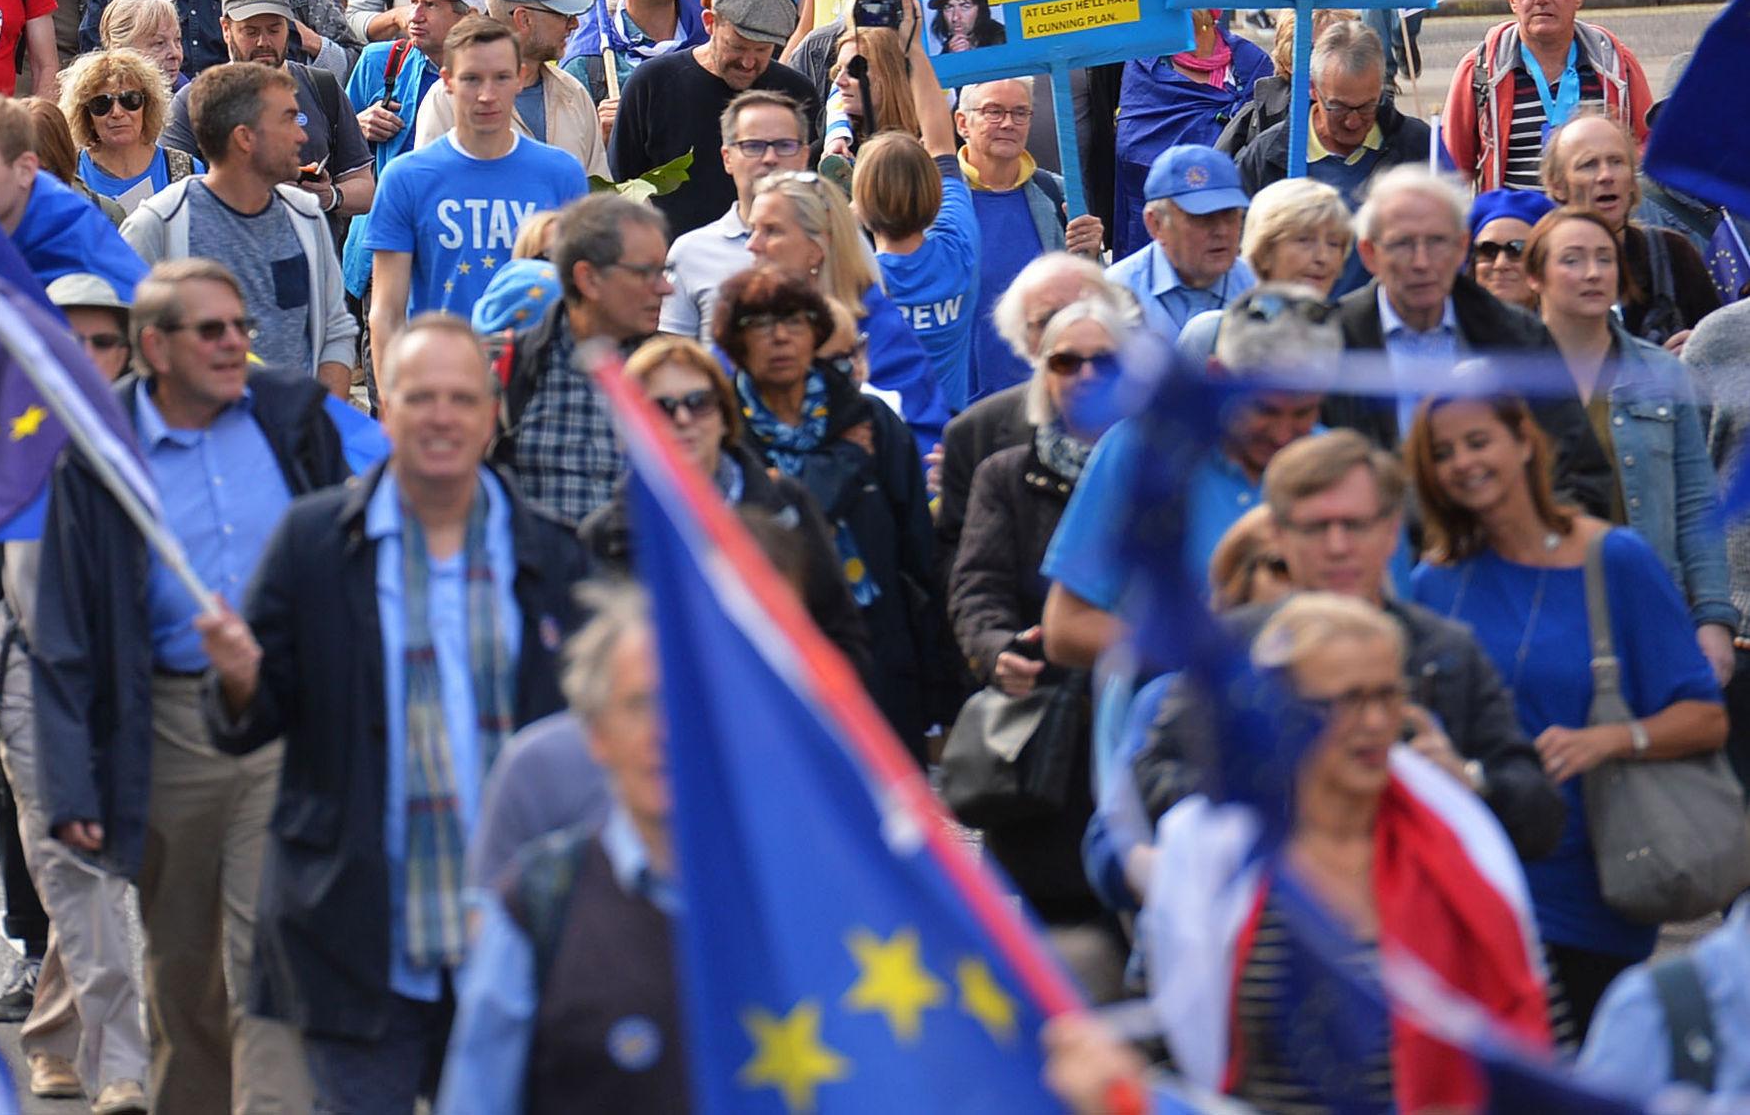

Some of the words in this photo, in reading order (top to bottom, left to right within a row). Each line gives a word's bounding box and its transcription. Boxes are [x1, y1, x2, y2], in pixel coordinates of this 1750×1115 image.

[1025, 6, 1039, 17] AT
[1040, 1, 1073, 16] LEAST
[1027, 24, 1034, 35] A
[1037, 18, 1085, 34] CUNNING
[1088, 12, 1119, 26] PLAN.
[436, 199, 537, 249] STAY
